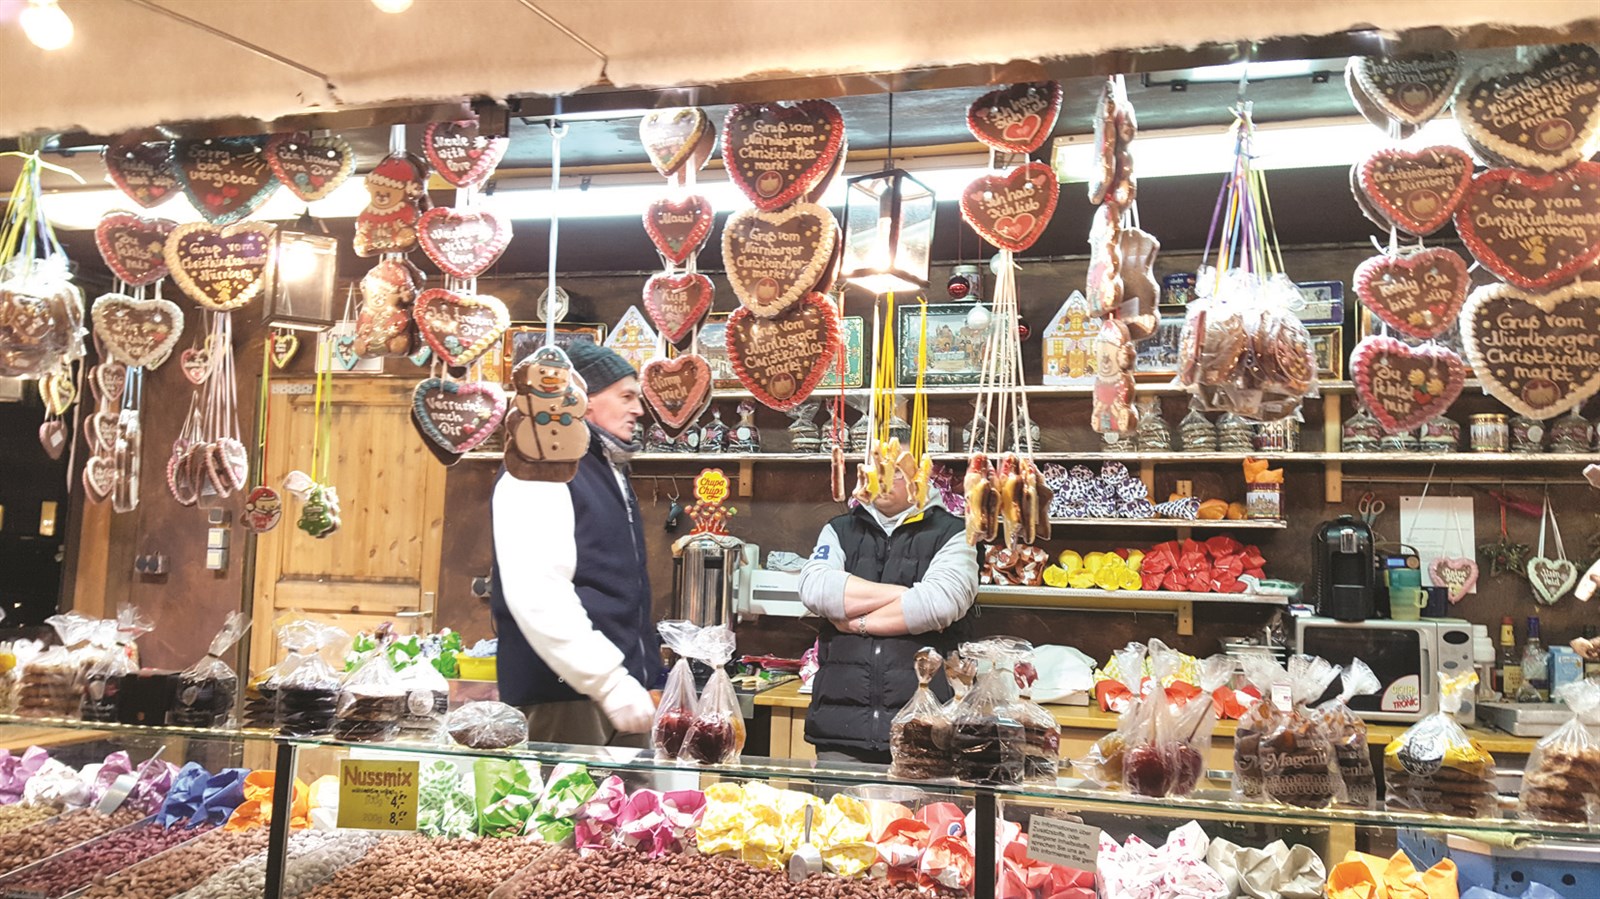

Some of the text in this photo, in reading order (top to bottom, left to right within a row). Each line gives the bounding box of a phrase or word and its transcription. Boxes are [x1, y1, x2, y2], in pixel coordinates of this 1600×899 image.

[1543, 62, 1578, 80] vom
[753, 120, 814, 138] Gruß vom
[189, 170, 258, 187] vergeben
[1016, 200, 1040, 213] lieb
[1543, 198, 1582, 208] vom
[778, 231, 800, 242] vom
[227, 241, 255, 252] vom
[1497, 312, 1586, 331] Gruß vom
[1482, 329, 1600, 354] Nürnberger
[1513, 365, 1575, 381] markt
[658, 388, 688, 400] mich
[1384, 400, 1411, 413] mir
[431, 412, 464, 424] nach
[438, 422, 462, 436] Dir
[700, 478, 725, 488] Chupa
[699, 487, 724, 499] Chups
[1393, 698, 1419, 709] TRONIC
[344, 765, 413, 788] Nussmix
